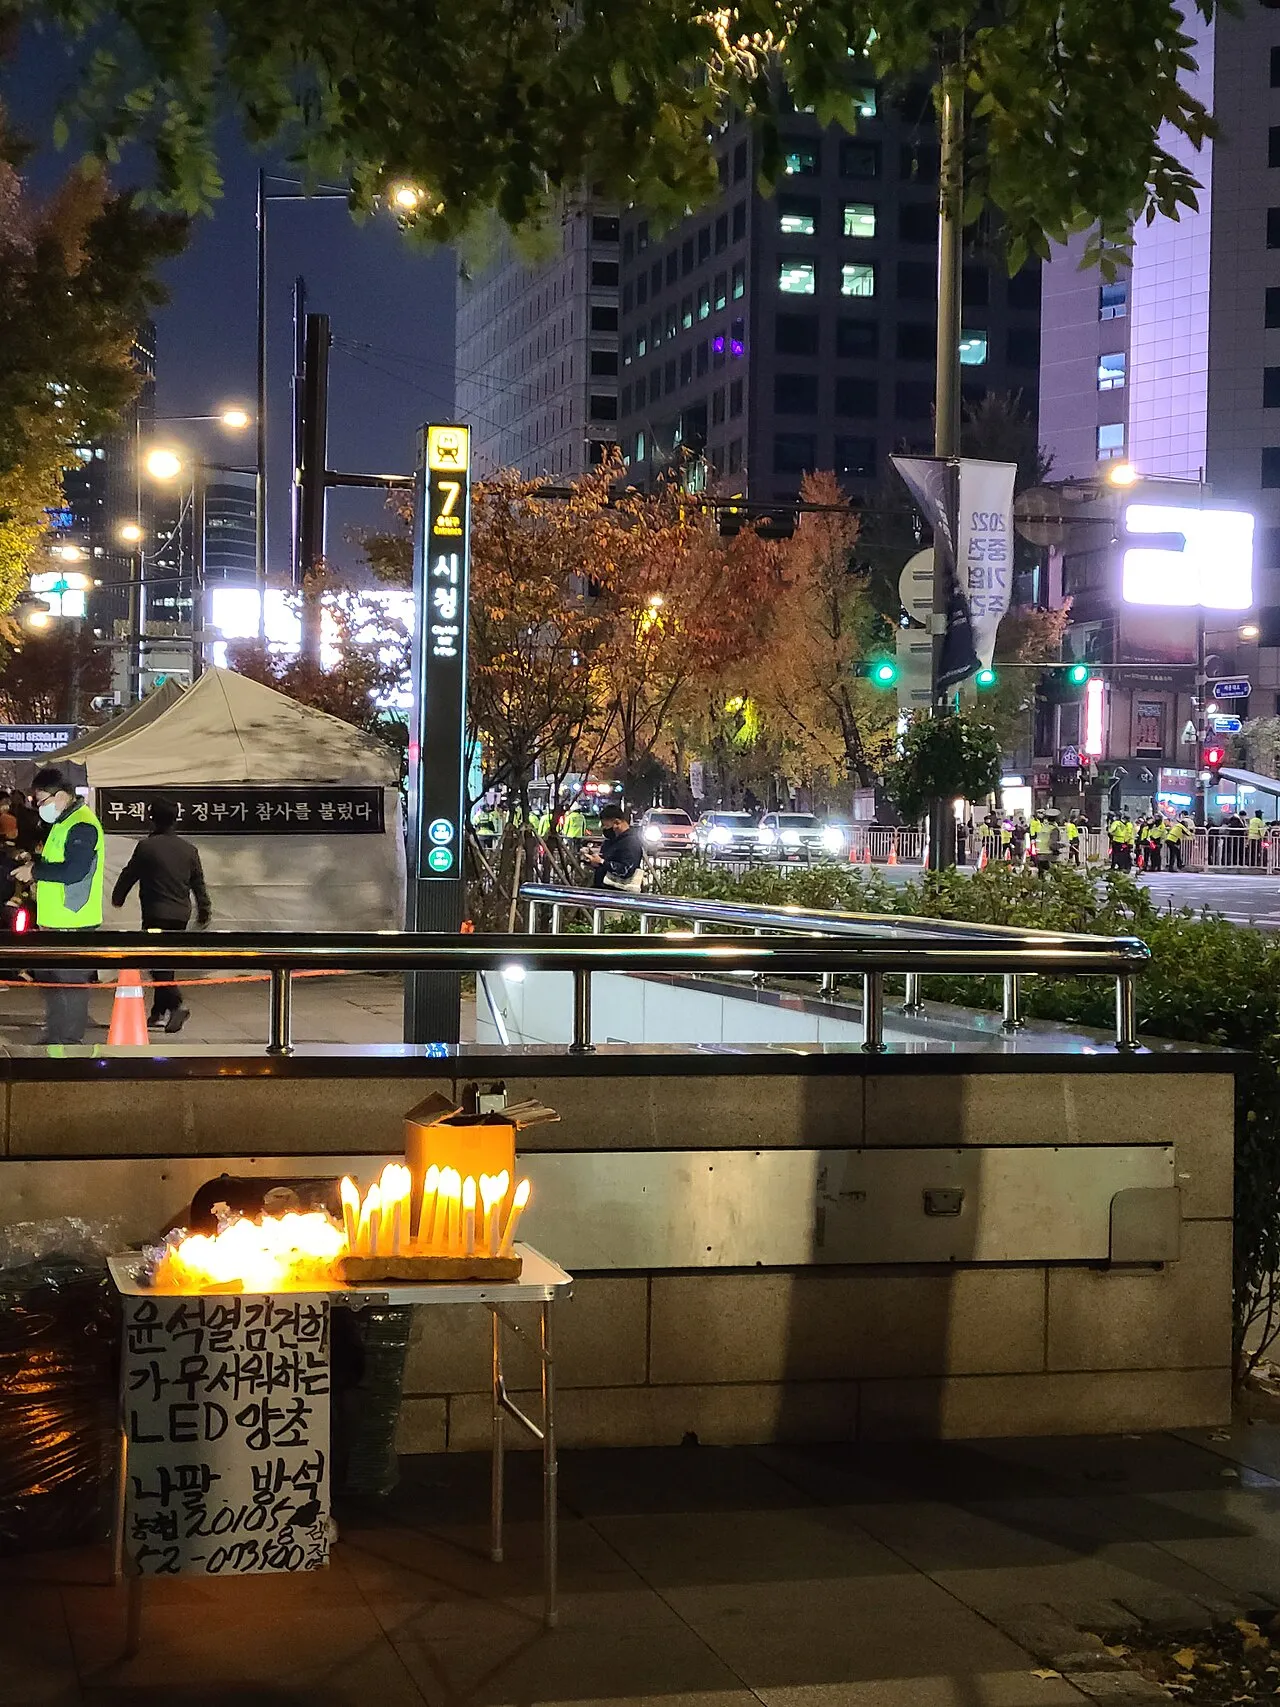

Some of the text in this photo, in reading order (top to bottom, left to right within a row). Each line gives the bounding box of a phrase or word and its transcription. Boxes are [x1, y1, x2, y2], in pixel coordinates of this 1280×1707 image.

[437, 481, 461, 516] 7
[433, 552, 459, 619] 시청
[191, 801, 249, 822] 정부가
[255, 801, 312, 822] 참사를
[317, 801, 373, 822] 불렀다
[131, 1396, 313, 1450] LED 양초
[250, 1449, 325, 1505] 방석
